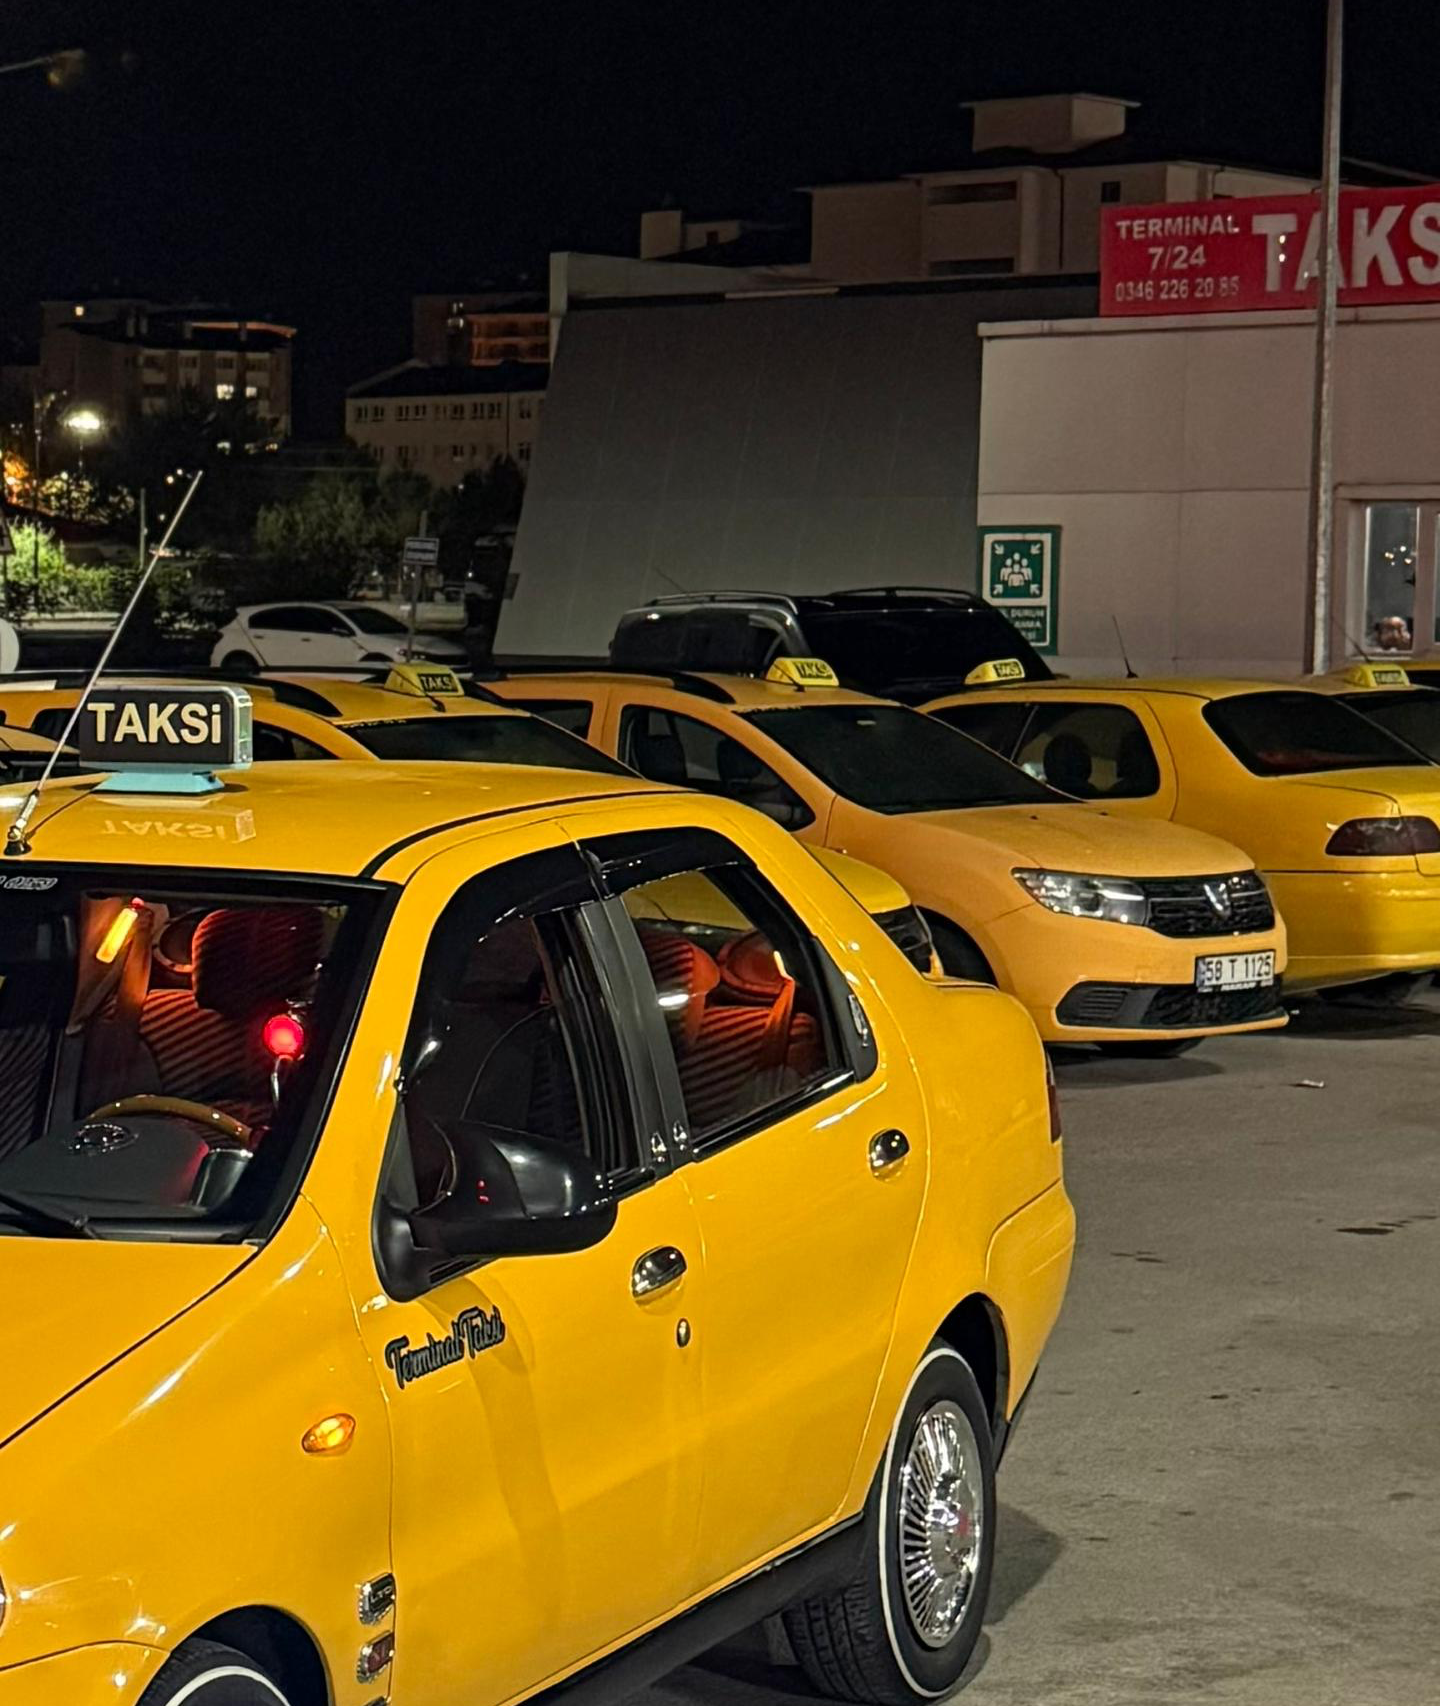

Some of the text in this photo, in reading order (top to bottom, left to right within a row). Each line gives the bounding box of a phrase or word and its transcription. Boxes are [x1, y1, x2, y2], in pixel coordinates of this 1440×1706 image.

[1148, 245, 1207, 271] 7/24
[1115, 280, 1154, 302] 0346
[1160, 278, 1189, 299] 226
[1194, 276, 1215, 298] 20
[1206, 954, 1272, 981] 58 T 1125
